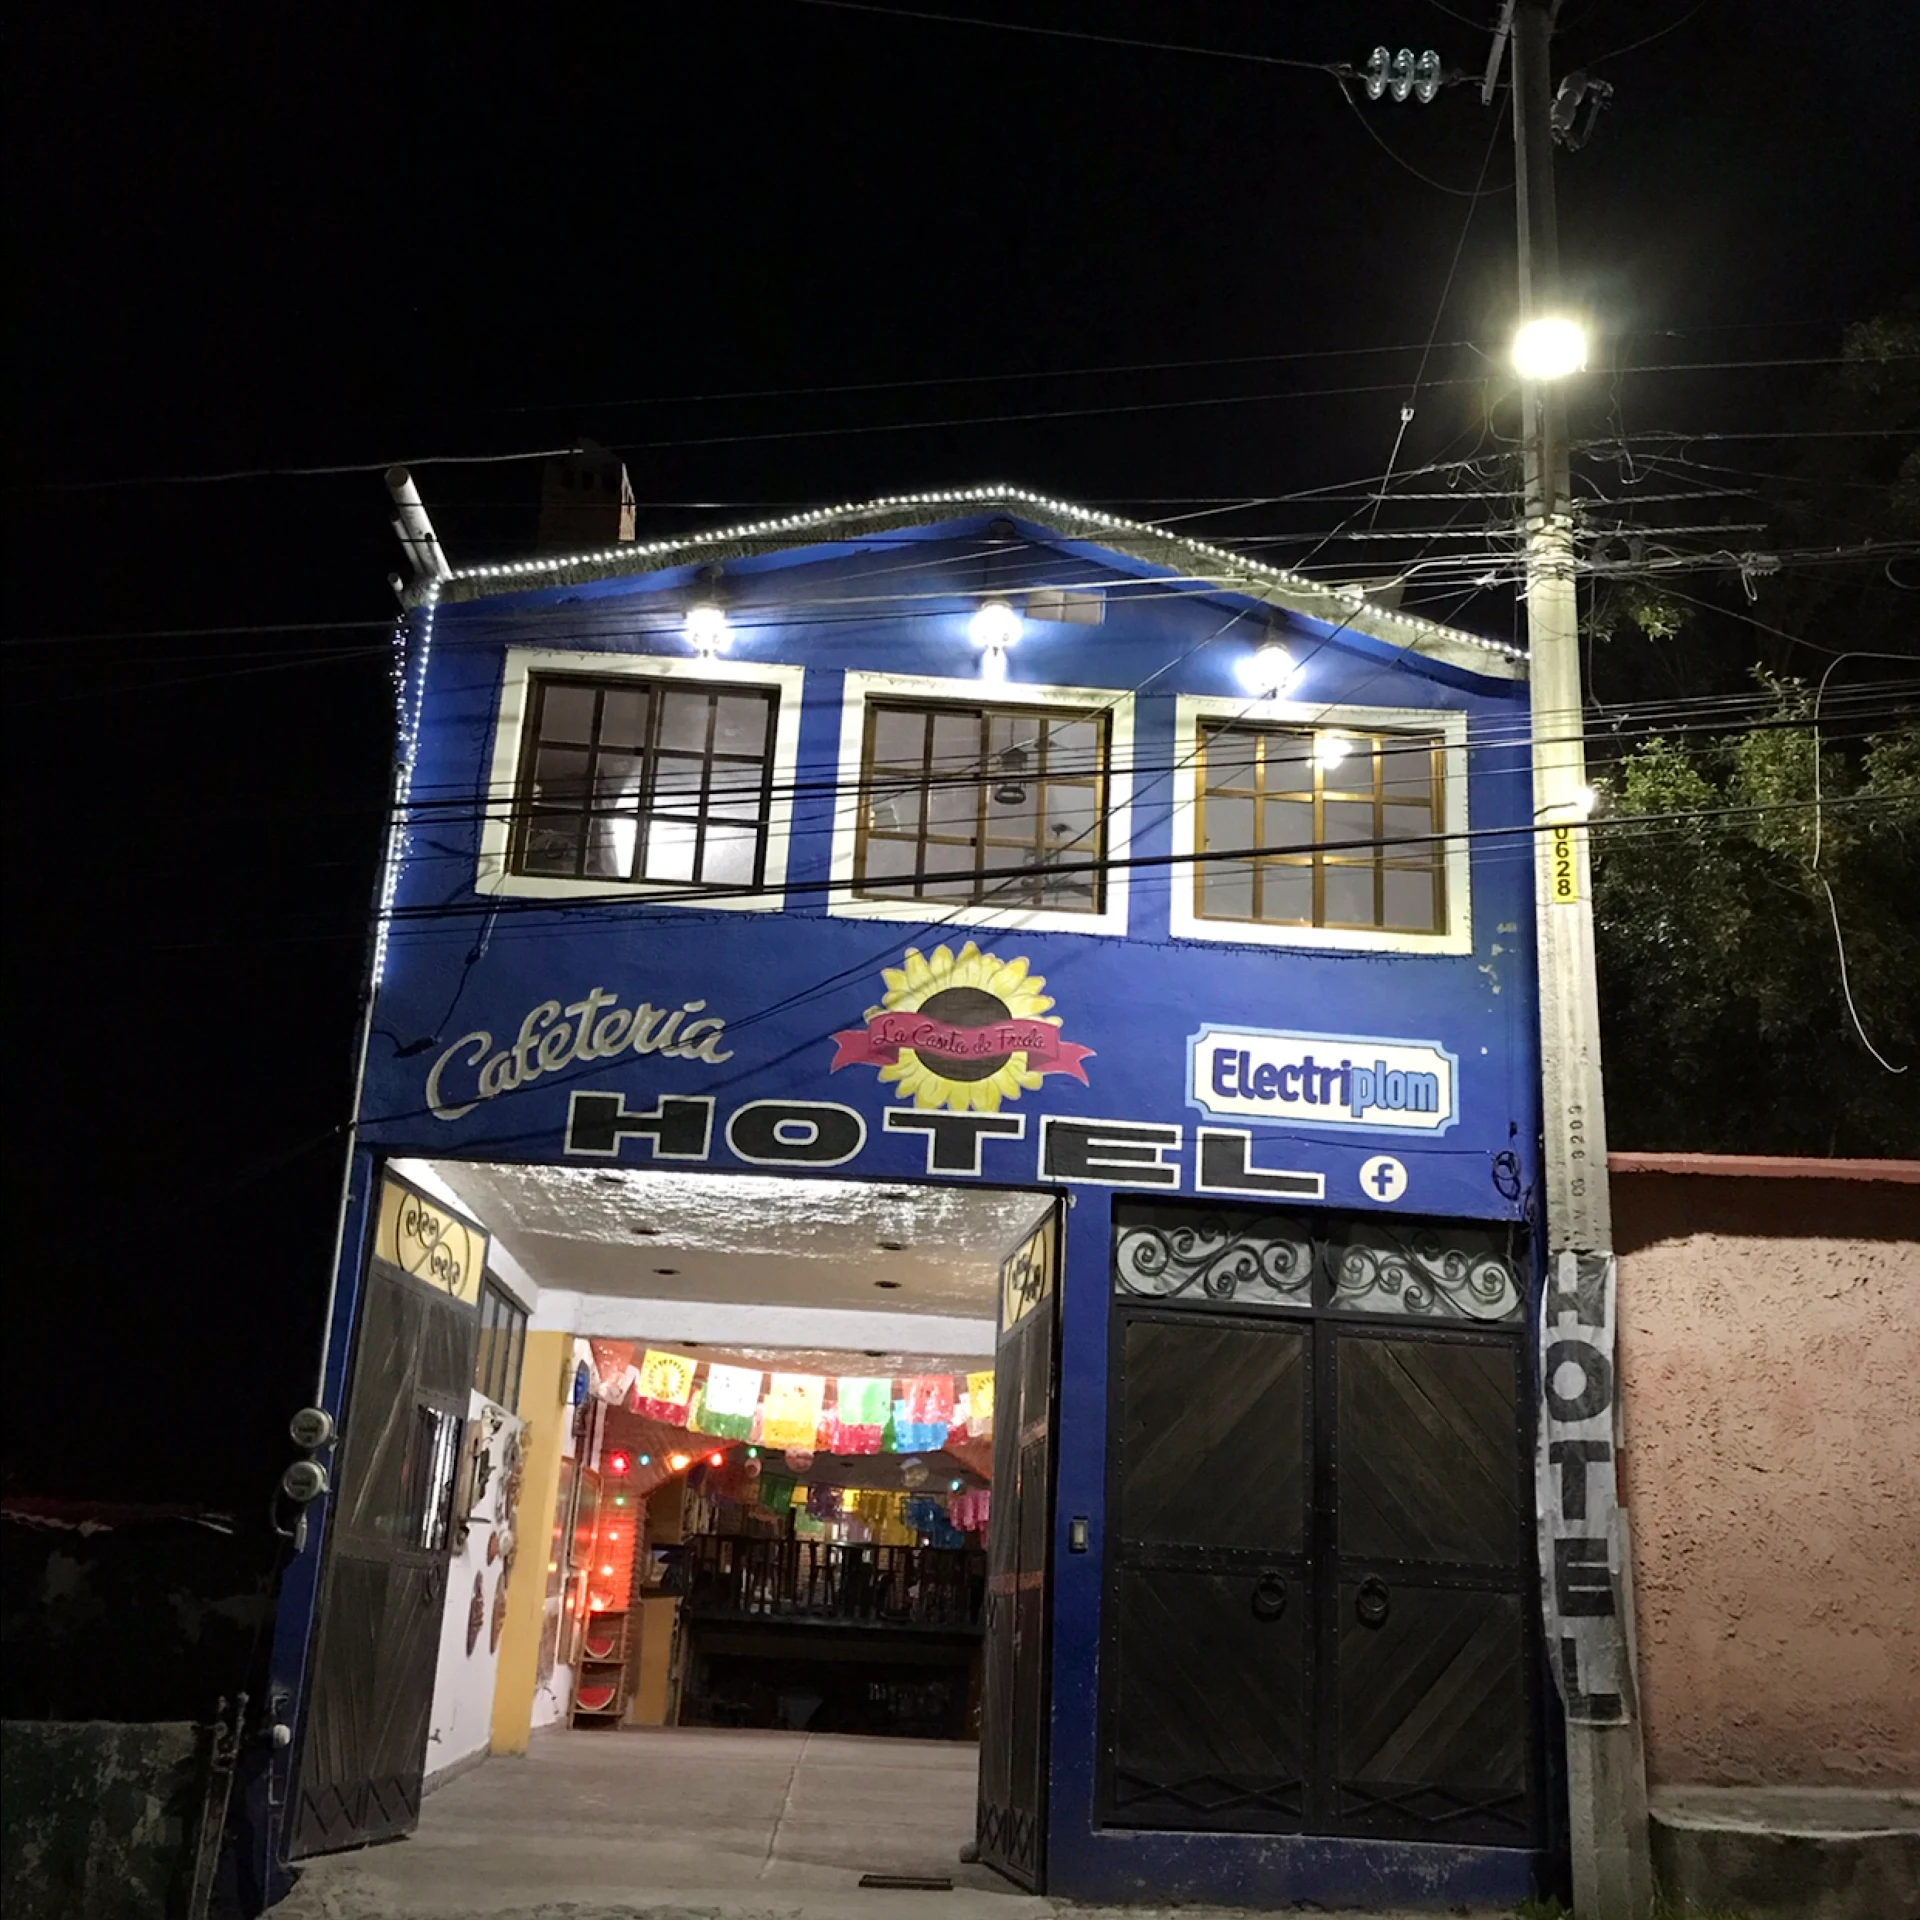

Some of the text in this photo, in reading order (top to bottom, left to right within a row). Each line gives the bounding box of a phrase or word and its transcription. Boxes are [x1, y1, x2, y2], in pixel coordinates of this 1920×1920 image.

[872, 1018, 1047, 1055] La Casita de Frida
[1212, 1048, 1440, 1118] Electriplom
[563, 1090, 1326, 1199] HOTEL
[1545, 1255, 1623, 1722] HOTEL
